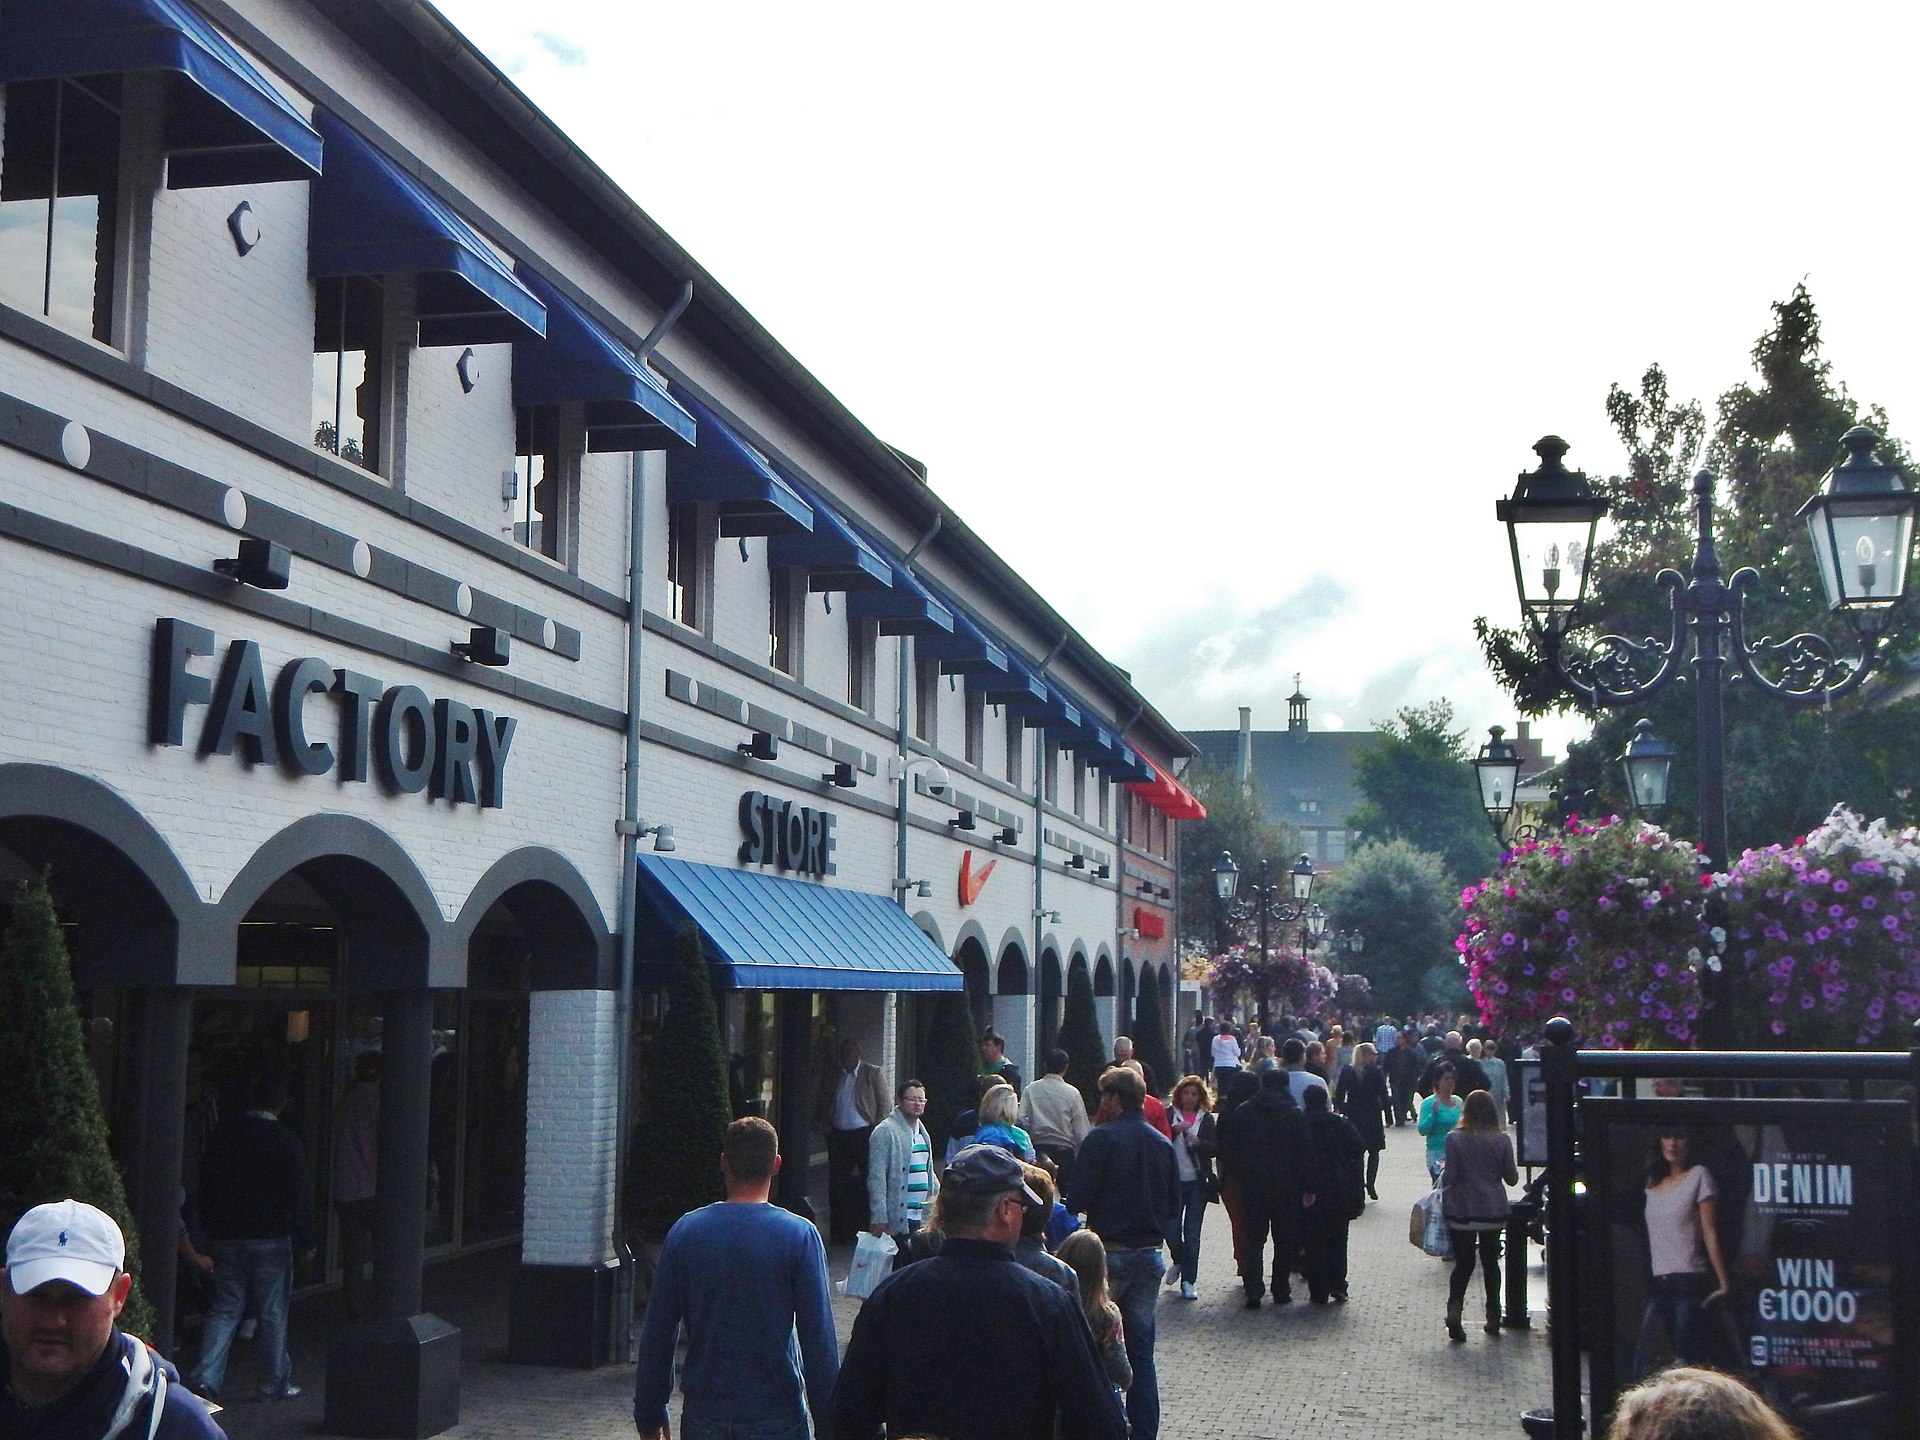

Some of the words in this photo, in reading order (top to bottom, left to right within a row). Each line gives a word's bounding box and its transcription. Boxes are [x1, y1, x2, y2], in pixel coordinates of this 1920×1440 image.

[151, 617, 517, 809] FACTORY
[739, 791, 837, 876] STORE
[1753, 1163, 1852, 1205] DENIM
[1776, 1258, 1834, 1288] WIN
